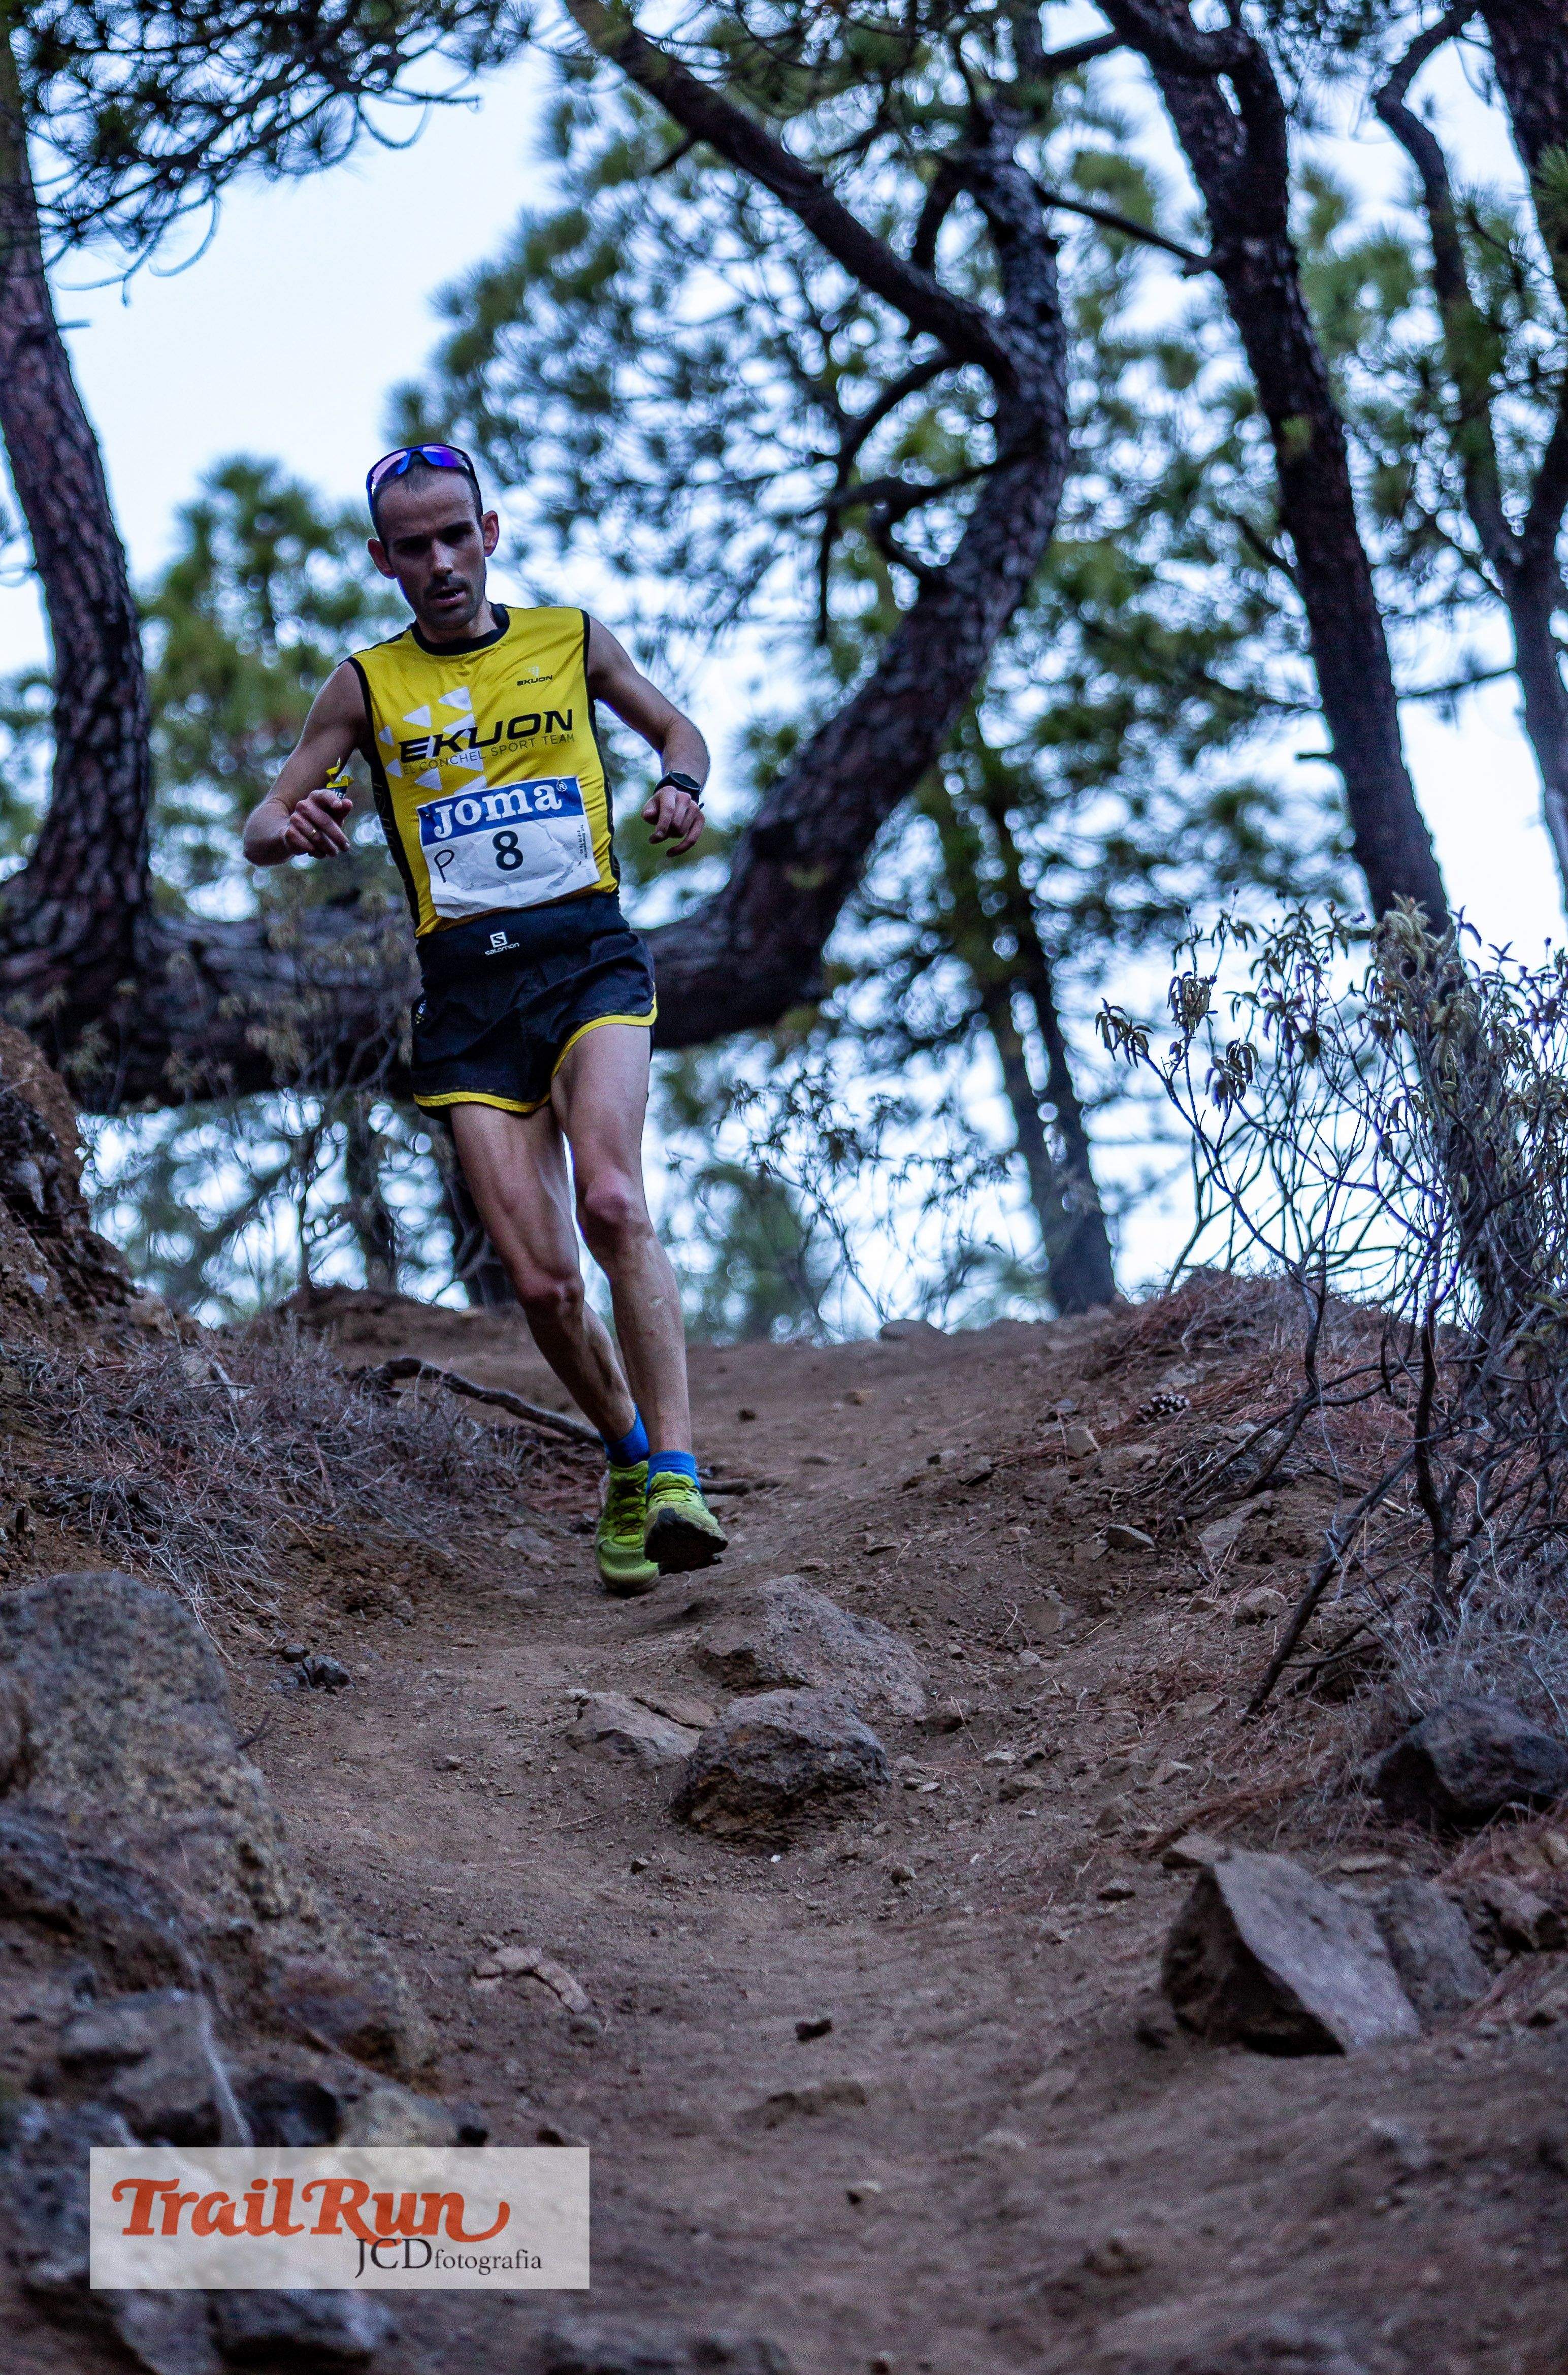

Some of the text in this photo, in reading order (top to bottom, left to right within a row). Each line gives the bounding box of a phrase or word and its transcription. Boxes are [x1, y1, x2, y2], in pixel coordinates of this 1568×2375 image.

[398, 709, 573, 763] EKUON
[403, 733, 575, 776] EL CONCHEL SPORT TEAM
[433, 849, 455, 883] P
[492, 830, 524, 871] 8
